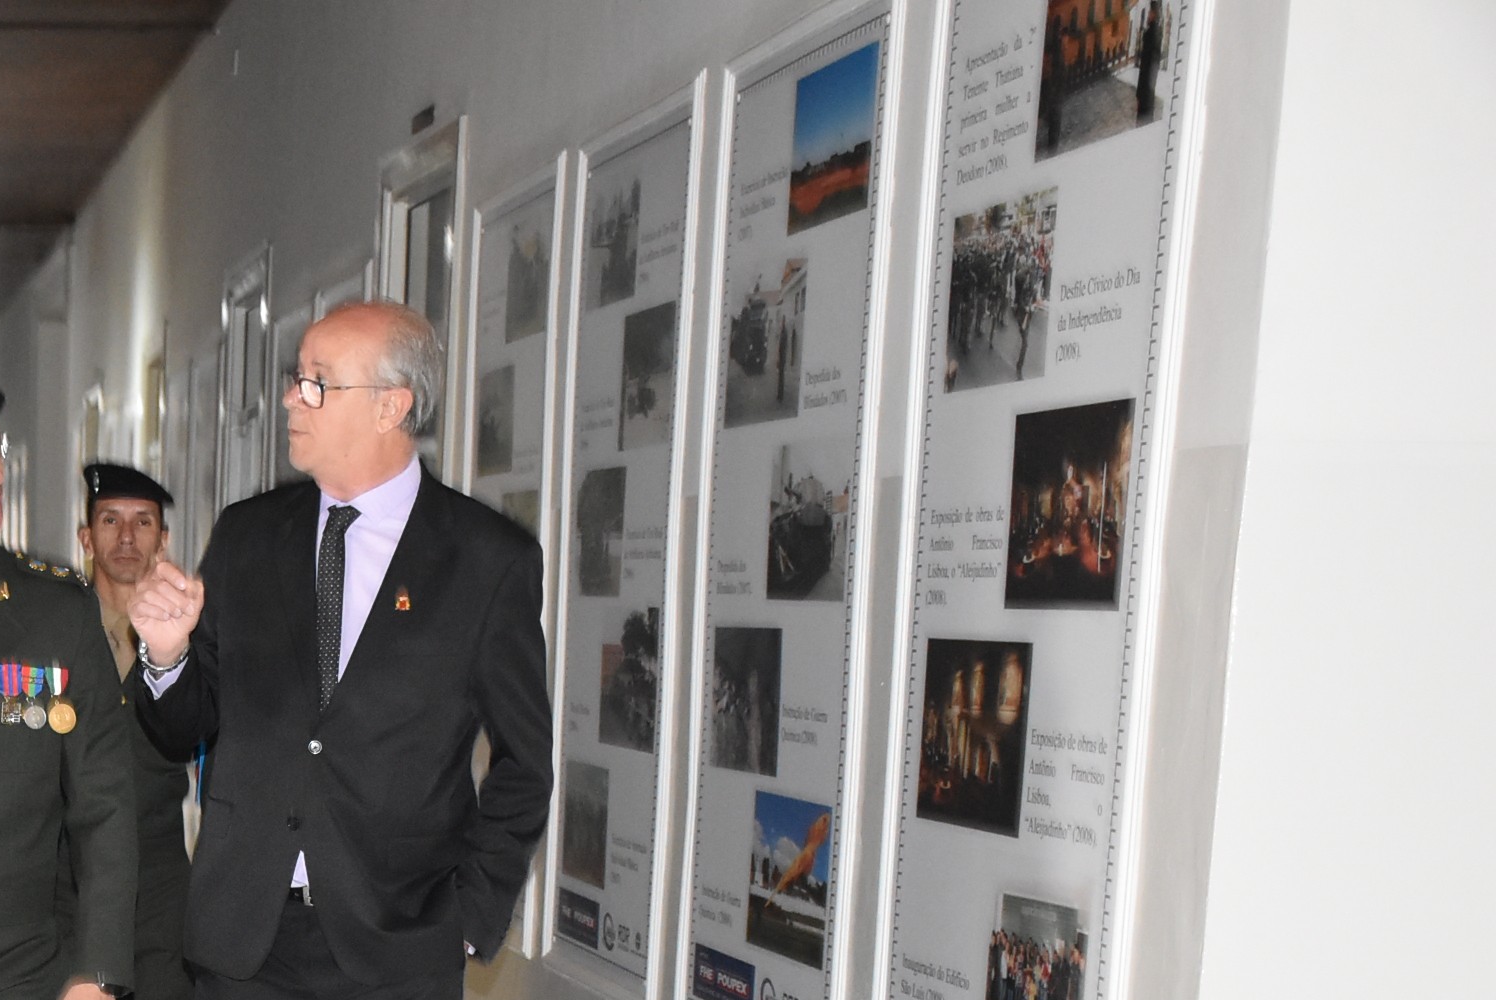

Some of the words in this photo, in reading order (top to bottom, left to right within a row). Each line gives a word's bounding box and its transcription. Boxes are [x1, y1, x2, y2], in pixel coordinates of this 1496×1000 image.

[966, 42, 1008, 74] Apresentação
[1014, 34, 1022, 51] da
[963, 81, 989, 100] Tenente
[960, 107, 987, 133] primeira
[995, 95, 1019, 115] mulher
[958, 142, 977, 158] servir
[980, 136, 989, 150] no
[993, 121, 1029, 146] Regimento
[956, 165, 984, 186] Deodoro
[1060, 279, 1086, 302] Desfile
[1087, 274, 1113, 295] Cívico
[1114, 270, 1124, 289] do
[1126, 266, 1141, 286] Dia
[1057, 314, 1066, 332] da
[1068, 303, 1122, 332] Independência
[931, 508, 962, 528] Exposição
[965, 506, 973, 522] de
[976, 506, 993, 522] obras
[996, 505, 1004, 521] de
[972, 534, 1003, 550] Francisco
[1031, 728, 1066, 751] Exposição
[1067, 734, 1076, 751] de
[1077, 735, 1097, 753] obras
[1099, 737, 1108, 755] de
[1028, 759, 1056, 778] Antônio
[1071, 764, 1105, 786] Francisco
[1026, 786, 1051, 808] Lisboa,
[1097, 804, 1103, 817] o
[716, 972, 751, 995] POUPEX
[936, 965, 945, 982] do
